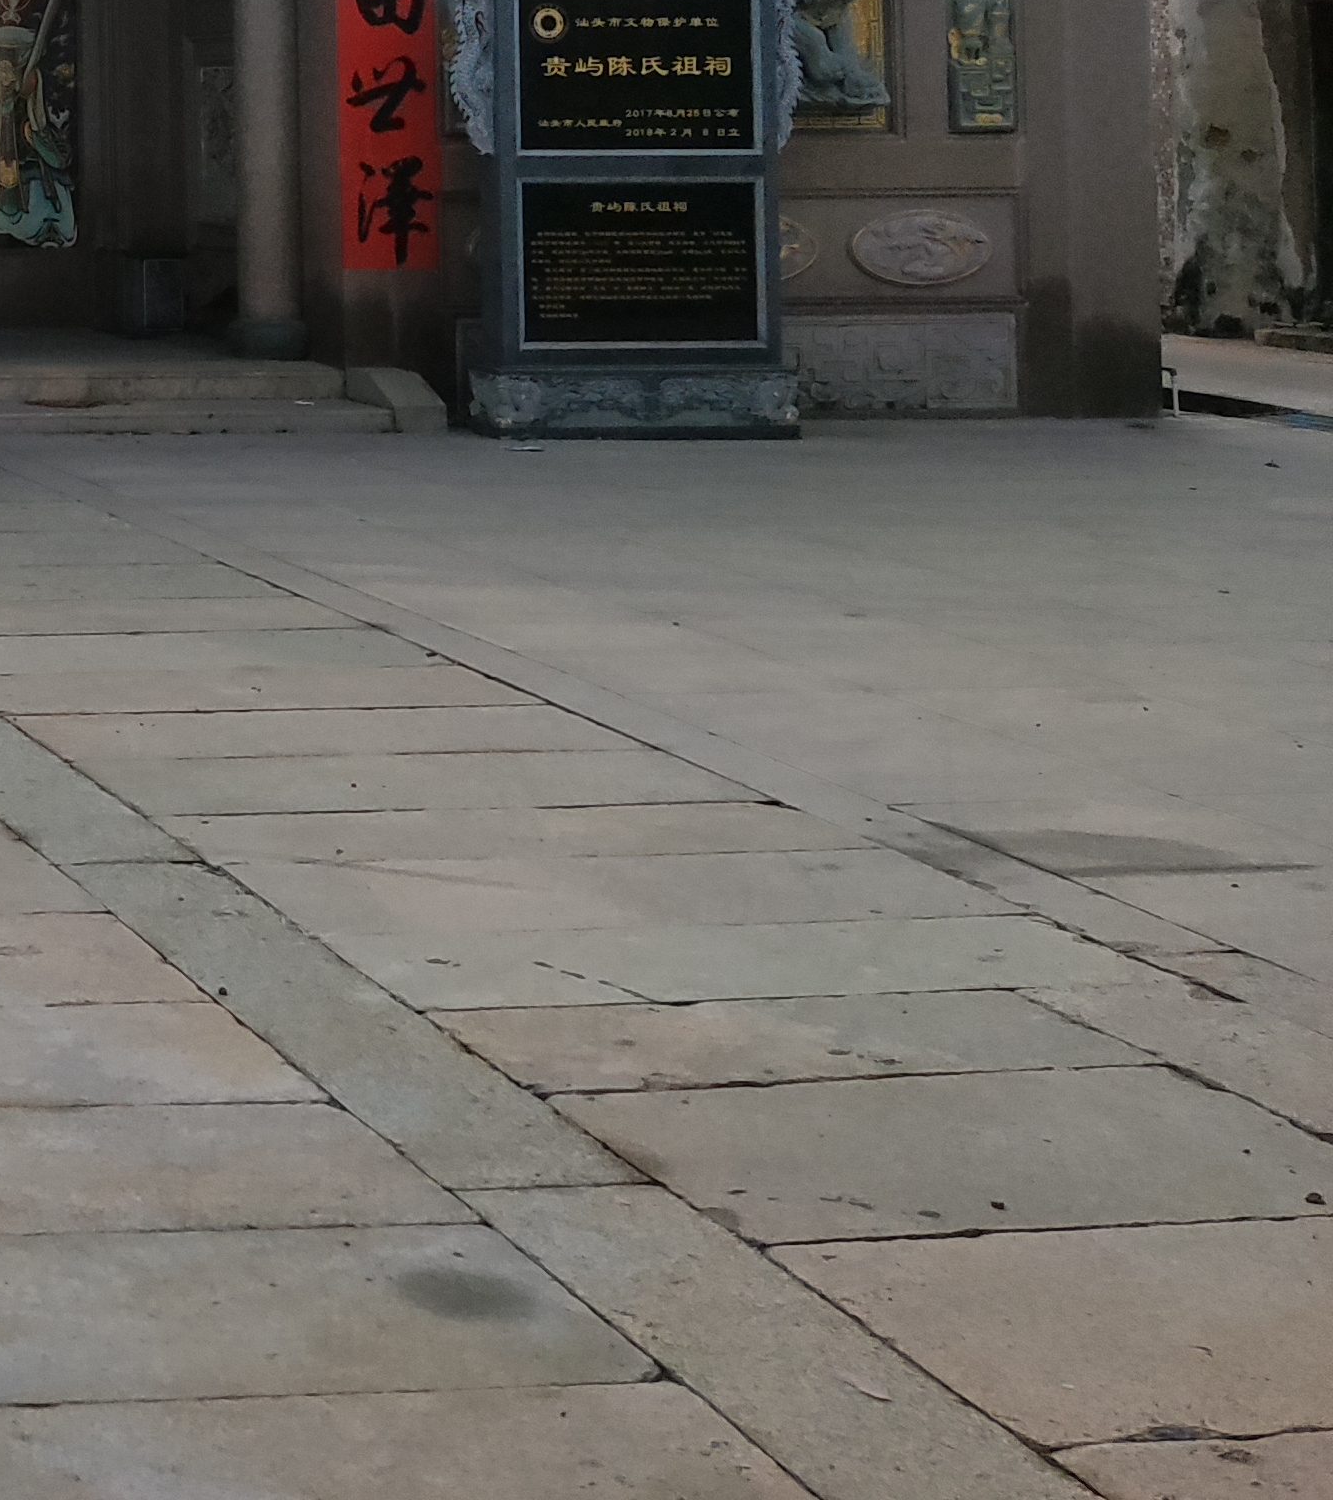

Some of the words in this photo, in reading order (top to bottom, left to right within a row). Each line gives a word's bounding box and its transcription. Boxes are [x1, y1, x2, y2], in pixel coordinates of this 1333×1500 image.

[574, 17, 720, 28] 汕头市文物保护单位
[540, 55, 732, 77] 贵屿陈氏祖祠
[590, 201, 688, 213] 贵屿陈氏祖祠
